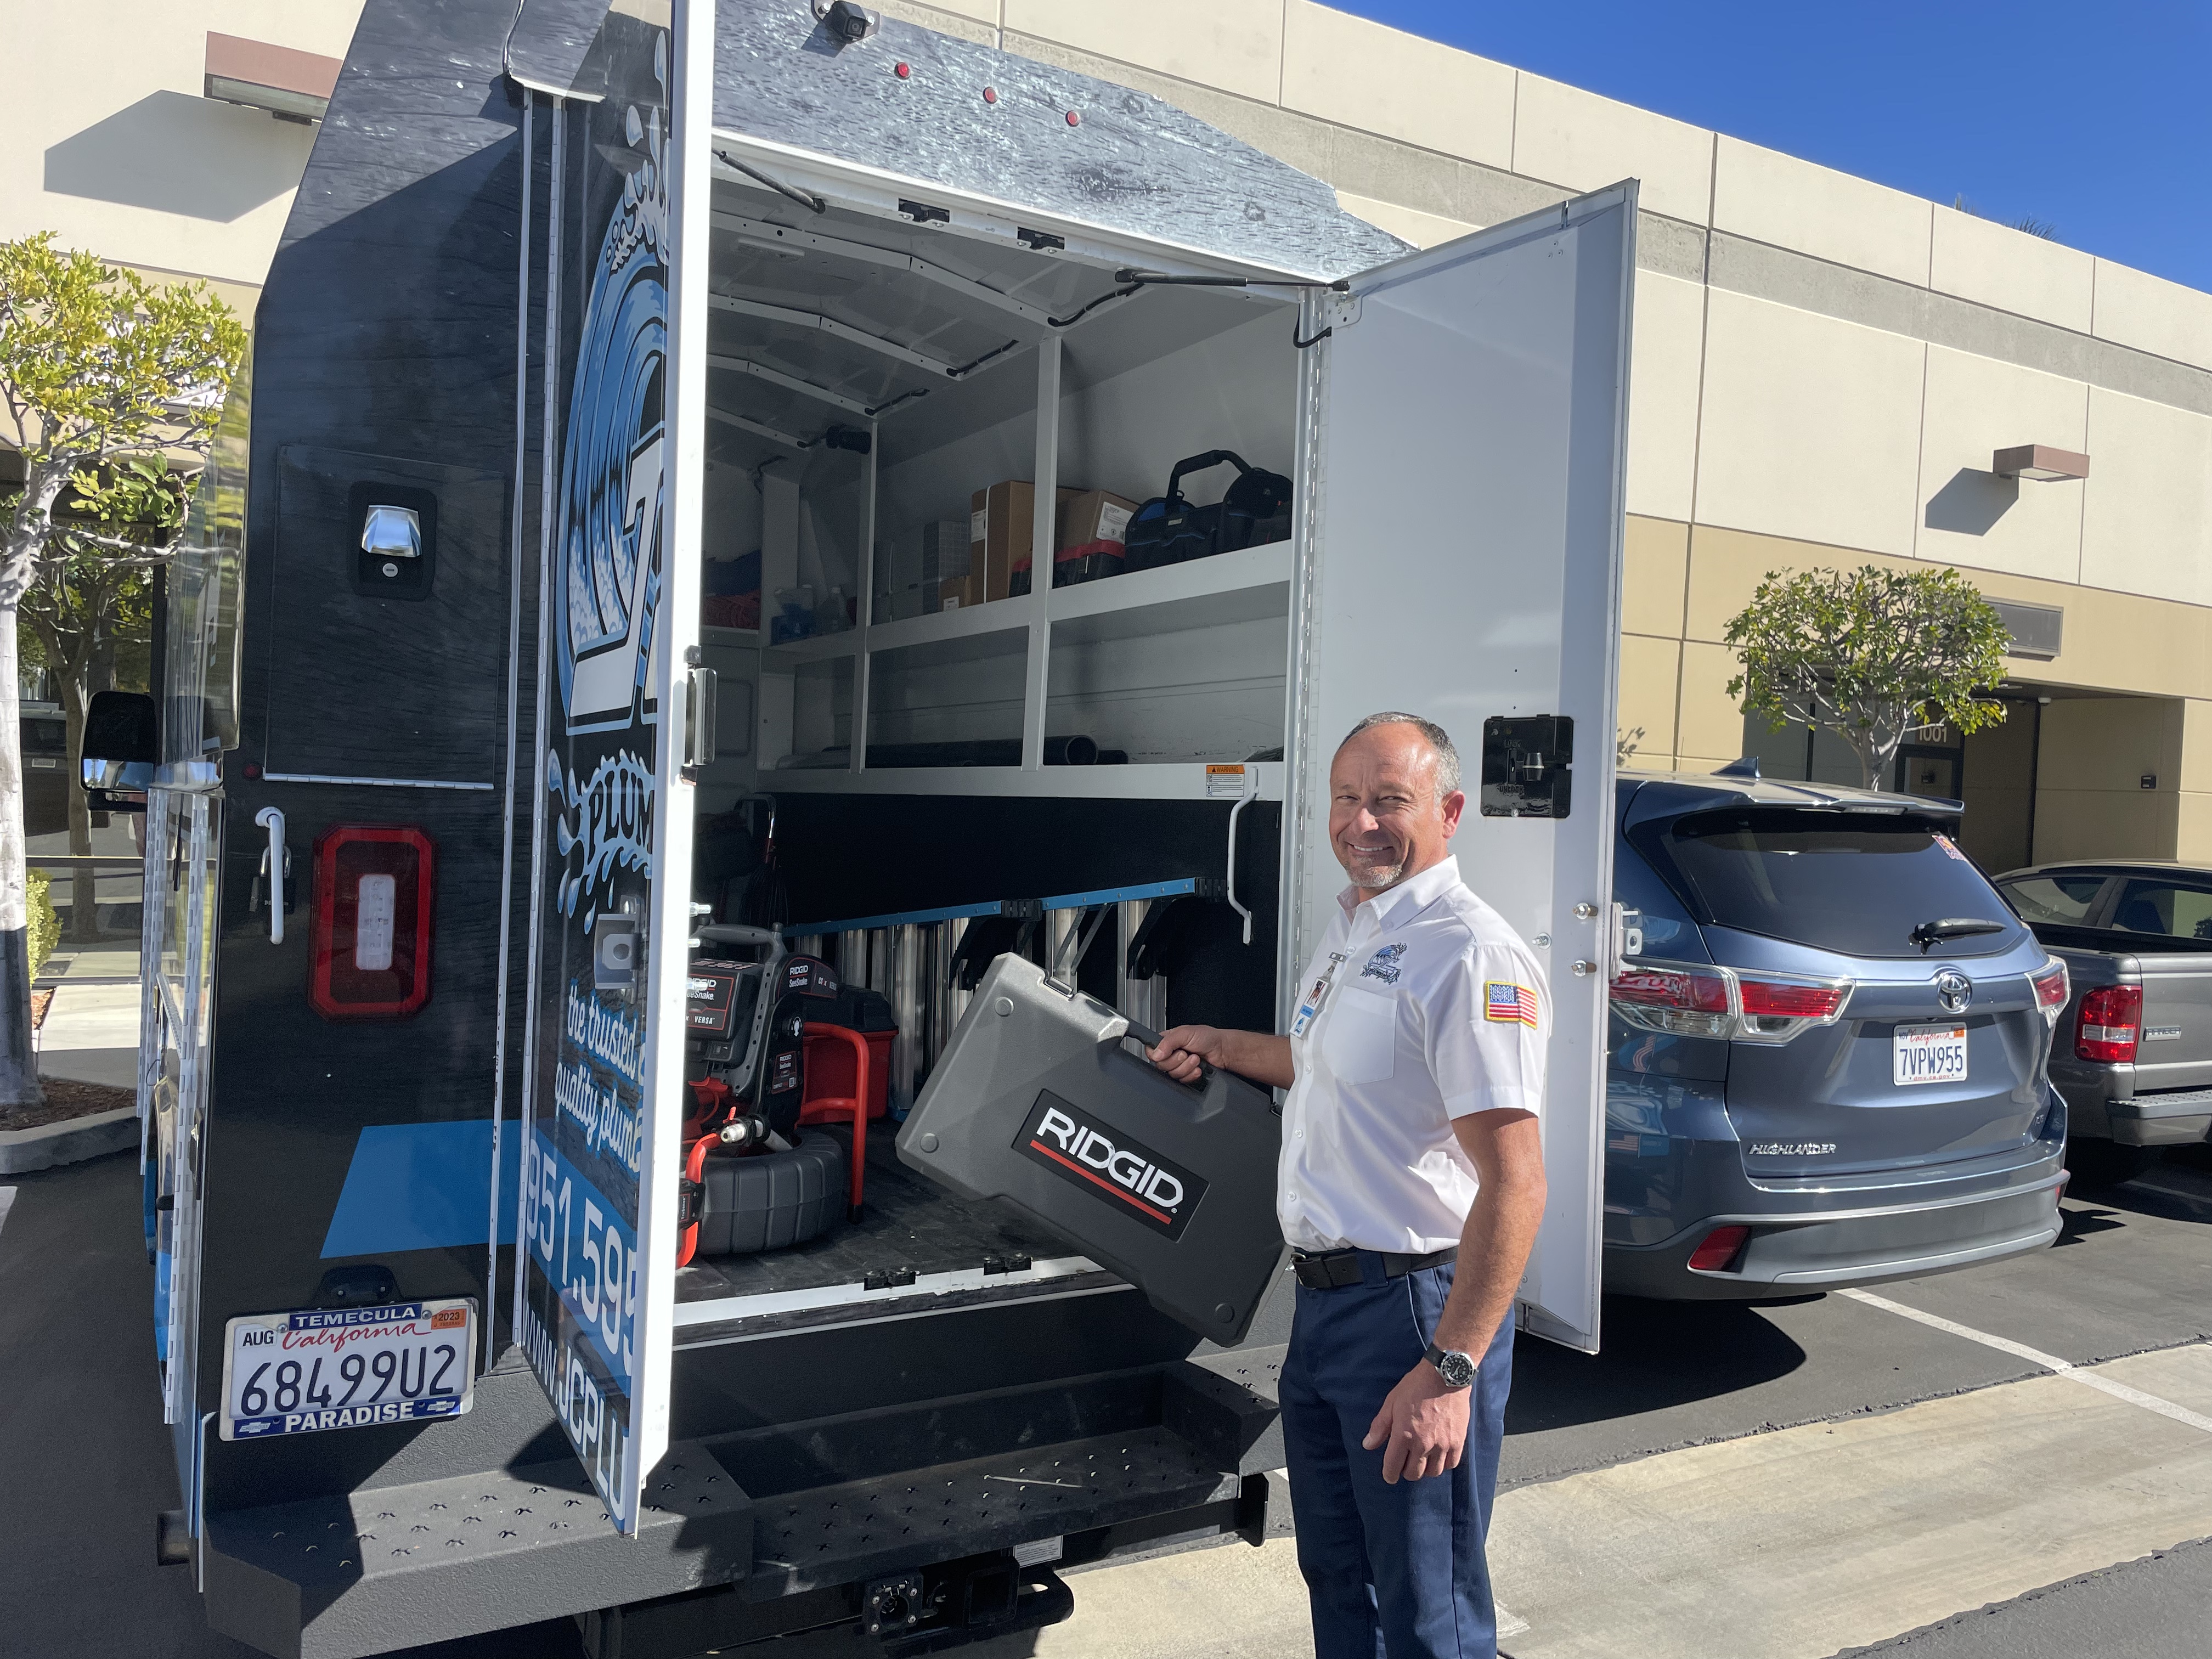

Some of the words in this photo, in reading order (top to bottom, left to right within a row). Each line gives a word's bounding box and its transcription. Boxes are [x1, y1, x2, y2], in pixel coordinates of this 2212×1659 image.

[1920, 726, 1947, 743] 1001
[789, 965, 809, 975] RIDGID
[568, 985, 586, 1044] the
[588, 996, 637, 1080] trusted
[1910, 1029, 1954, 1046] California
[1900, 1045, 1963, 1075] 7VPW955
[555, 1062, 598, 1146] quality
[1036, 1107, 1184, 1207] RIDGID
[1749, 1143, 1837, 1155] HIGHLANDER
[295, 1306, 416, 1328] TEMECULA
[438, 1312, 460, 1322] 2023
[242, 1329, 274, 1347] AUG
[282, 1322, 432, 1353] California
[240, 1344, 456, 1417] 68499U2
[285, 1401, 415, 1433] PARADISE
